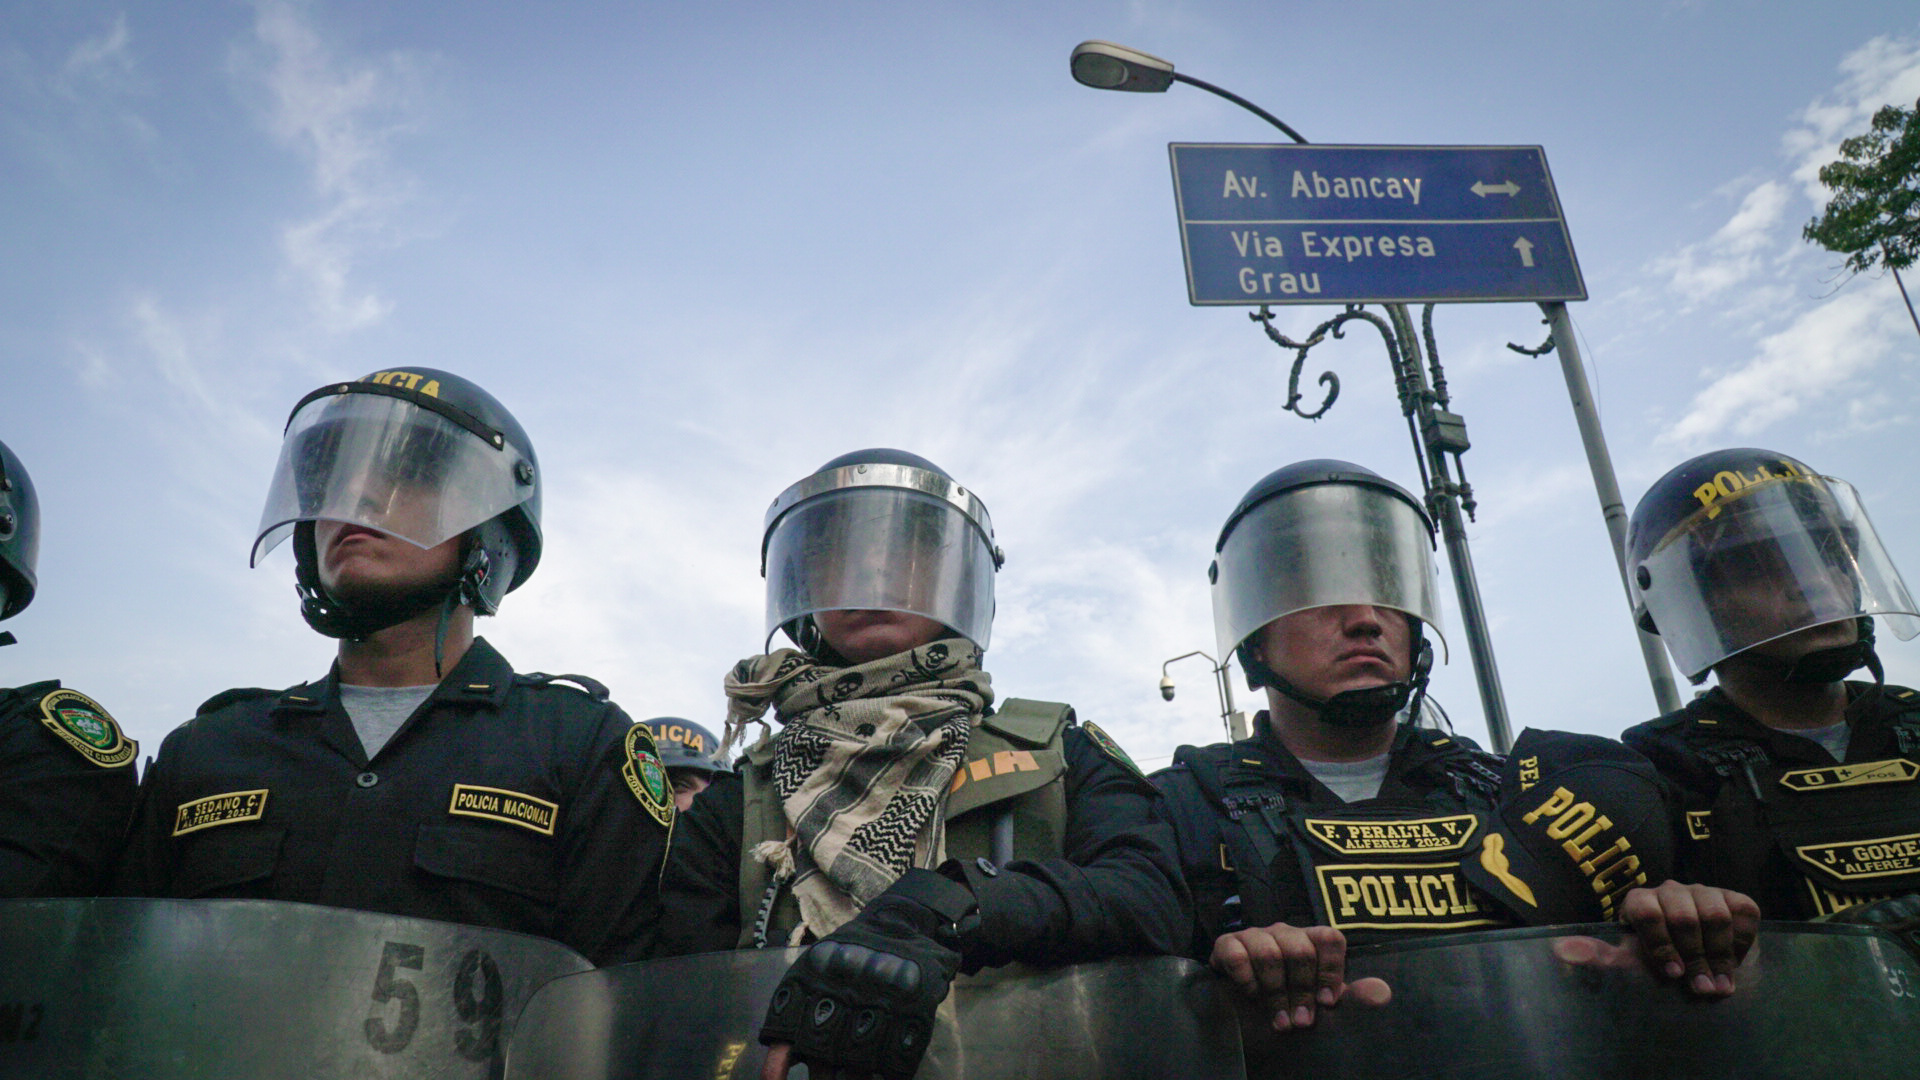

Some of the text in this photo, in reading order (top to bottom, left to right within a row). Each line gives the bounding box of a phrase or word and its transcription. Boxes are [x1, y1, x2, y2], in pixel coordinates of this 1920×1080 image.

[1223, 170, 1421, 205] Av. Abancay
[1231, 231, 1436, 262] Via Expresa
[1239, 267, 1321, 294] Grau
[649, 724, 704, 753] LICIA
[195, 797, 240, 816] SEDANO
[247, 794, 259, 807] C.
[458, 793, 549, 826] POLICIA NACIONAL
[182, 807, 251, 829] ALFEREZ 2023
[1323, 822, 1462, 839] F. PERALTA V.
[1346, 837, 1451, 849] ALFEREZ 2023
[1522, 786, 1648, 923] POLICI
[1824, 840, 1920, 864] J. GOME
[1846, 858, 1913, 873] ALFEREZ
